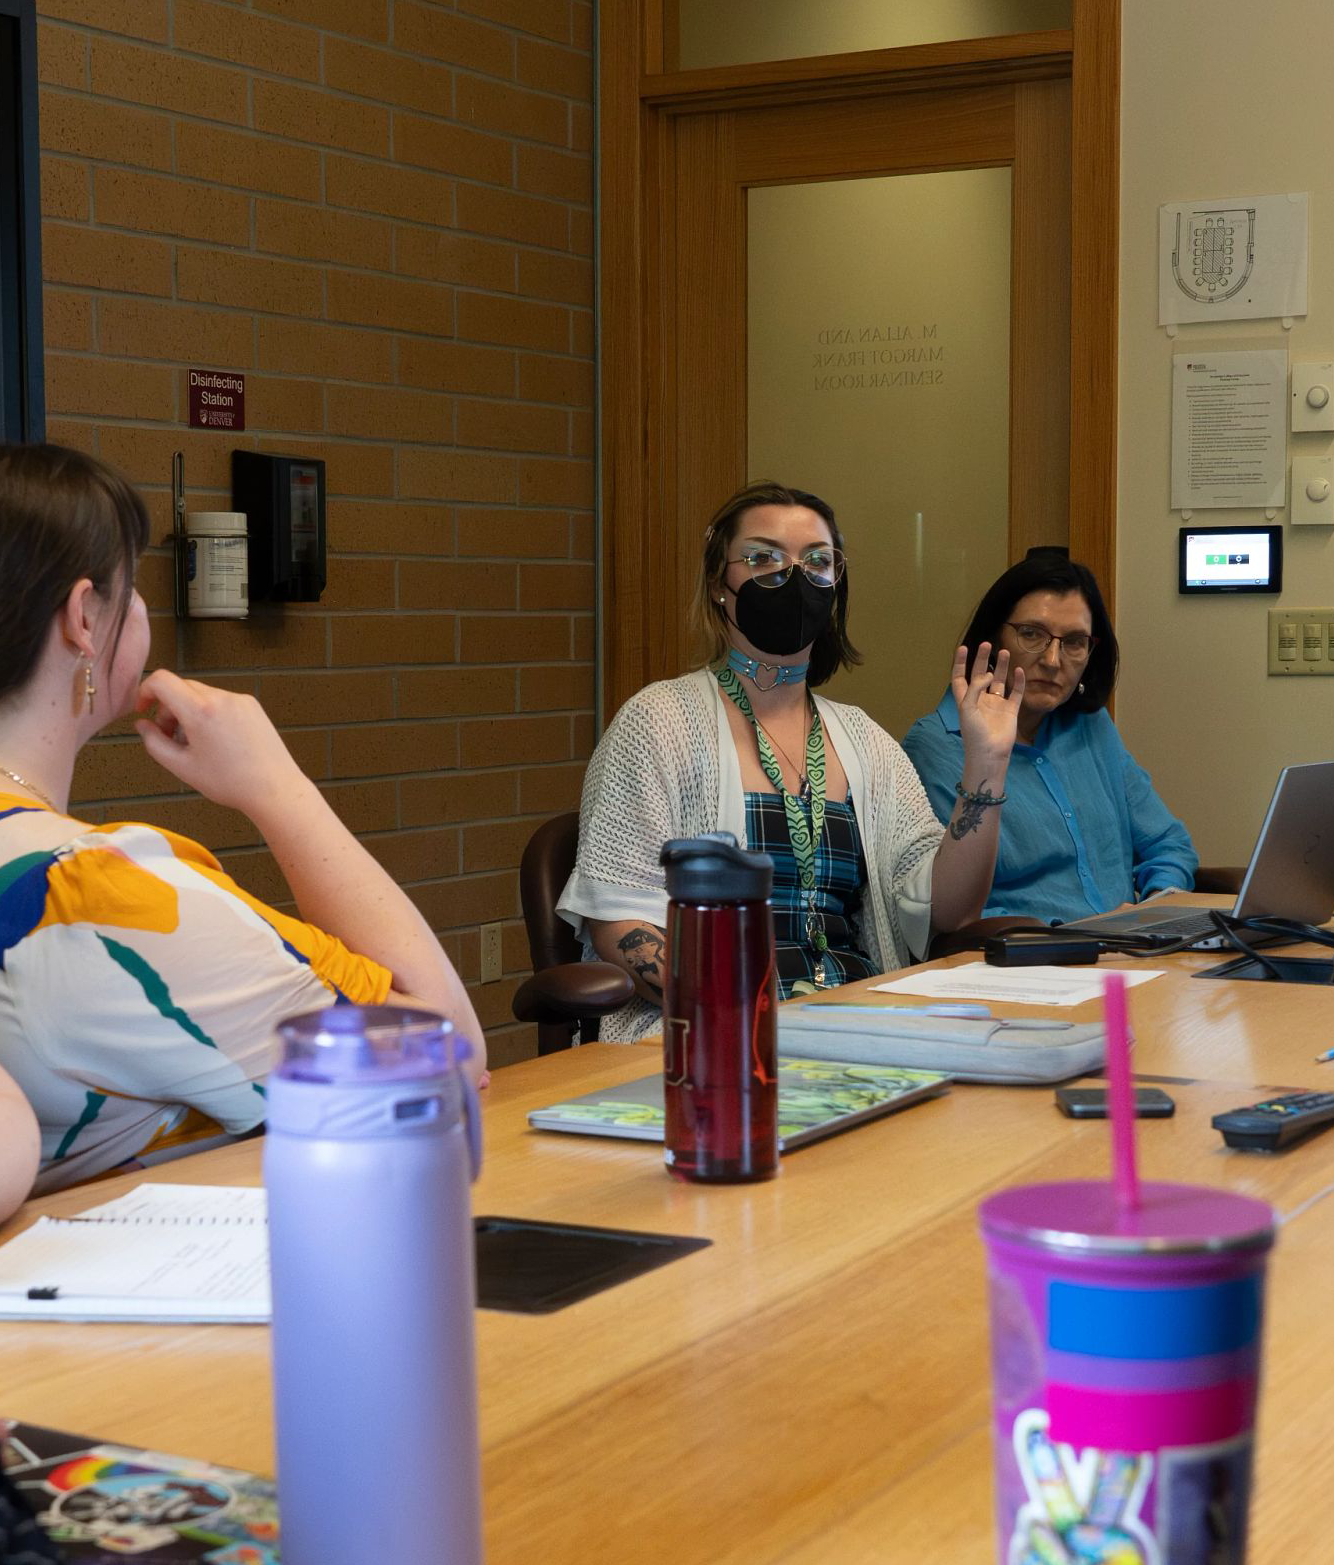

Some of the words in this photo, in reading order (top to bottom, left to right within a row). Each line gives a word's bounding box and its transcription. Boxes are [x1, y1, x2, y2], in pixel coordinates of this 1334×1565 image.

[190, 372, 243, 394] Disinfecting
[201, 391, 234, 407] Station
[208, 417, 234, 427] DENVER
